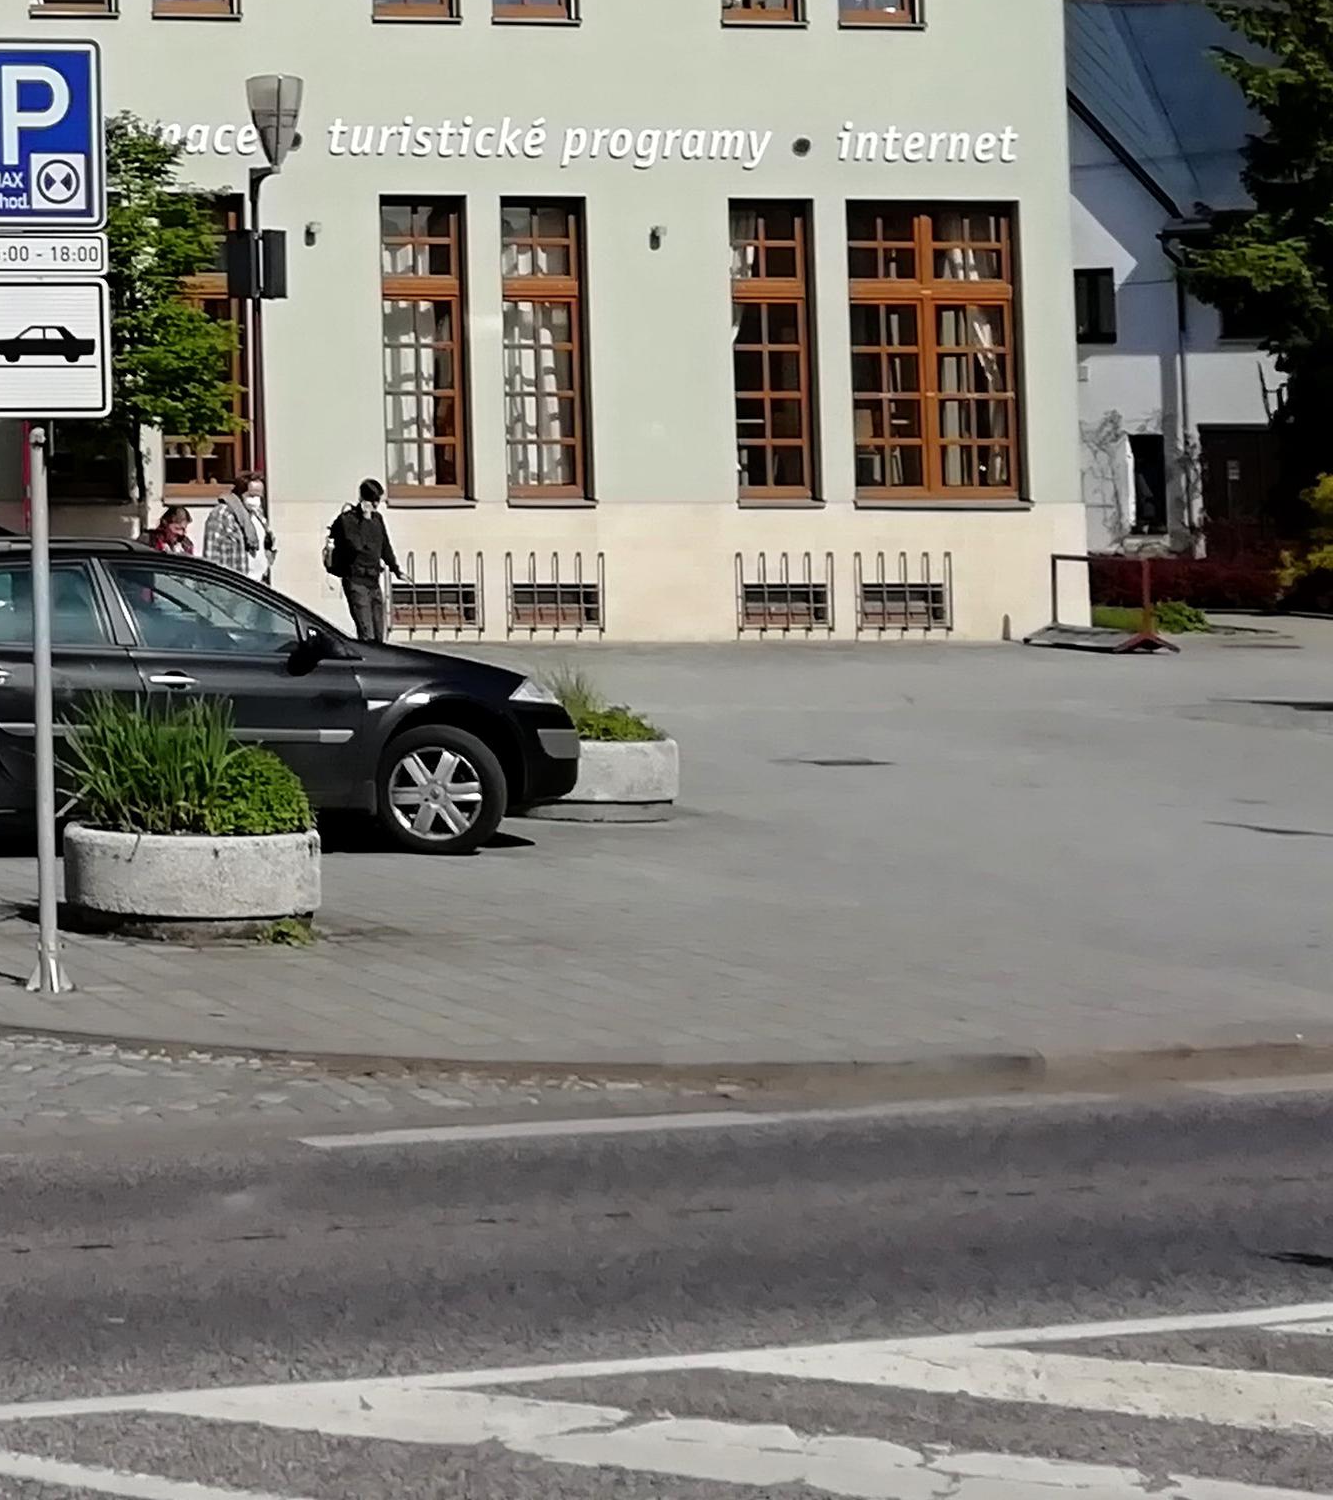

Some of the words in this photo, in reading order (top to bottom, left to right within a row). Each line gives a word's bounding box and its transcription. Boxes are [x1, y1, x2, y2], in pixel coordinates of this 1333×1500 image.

[0, 64, 71, 165] P
[327, 116, 547, 158] turistické
[560, 124, 773, 170] programy
[836, 121, 1020, 164] internet
[50, 246, 99, 262] 18:00
